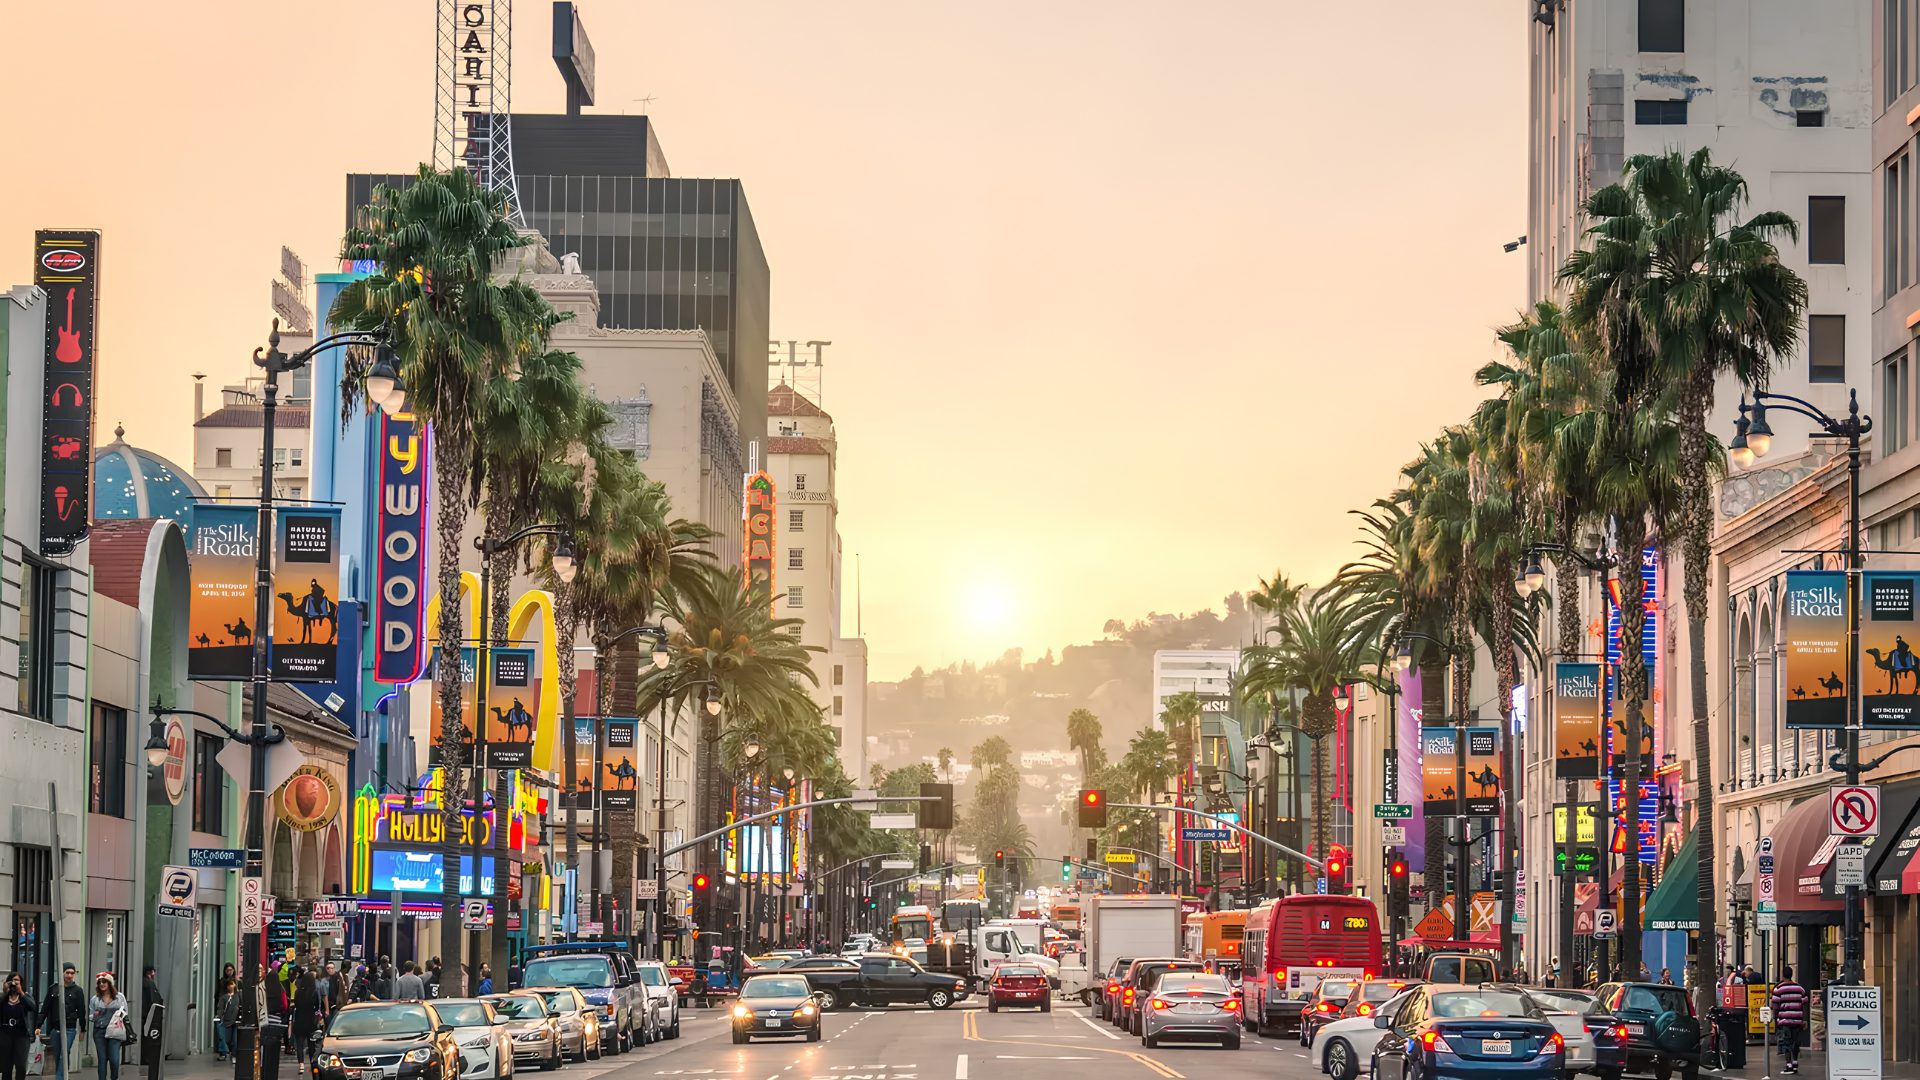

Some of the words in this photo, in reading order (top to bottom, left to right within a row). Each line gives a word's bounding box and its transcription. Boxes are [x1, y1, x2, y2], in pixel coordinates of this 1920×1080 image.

[217, 524, 249, 543] Silk
[384, 412, 419, 653] YWOOD
[203, 536, 253, 557] Road
[1808, 587, 1839, 604] Silk
[1796, 598, 1843, 616] Road
[1571, 676, 1594, 688] Silk
[1563, 684, 1597, 698] Road
[390, 811, 490, 845] HOLLYOOD
[1838, 847, 1863, 856] LAPD
[314, 902, 336, 914] ATM
[1346, 917, 1365, 928] 780
[1831, 990, 1877, 999] PUBLIC
[1830, 1000, 1878, 1009] PARKING
